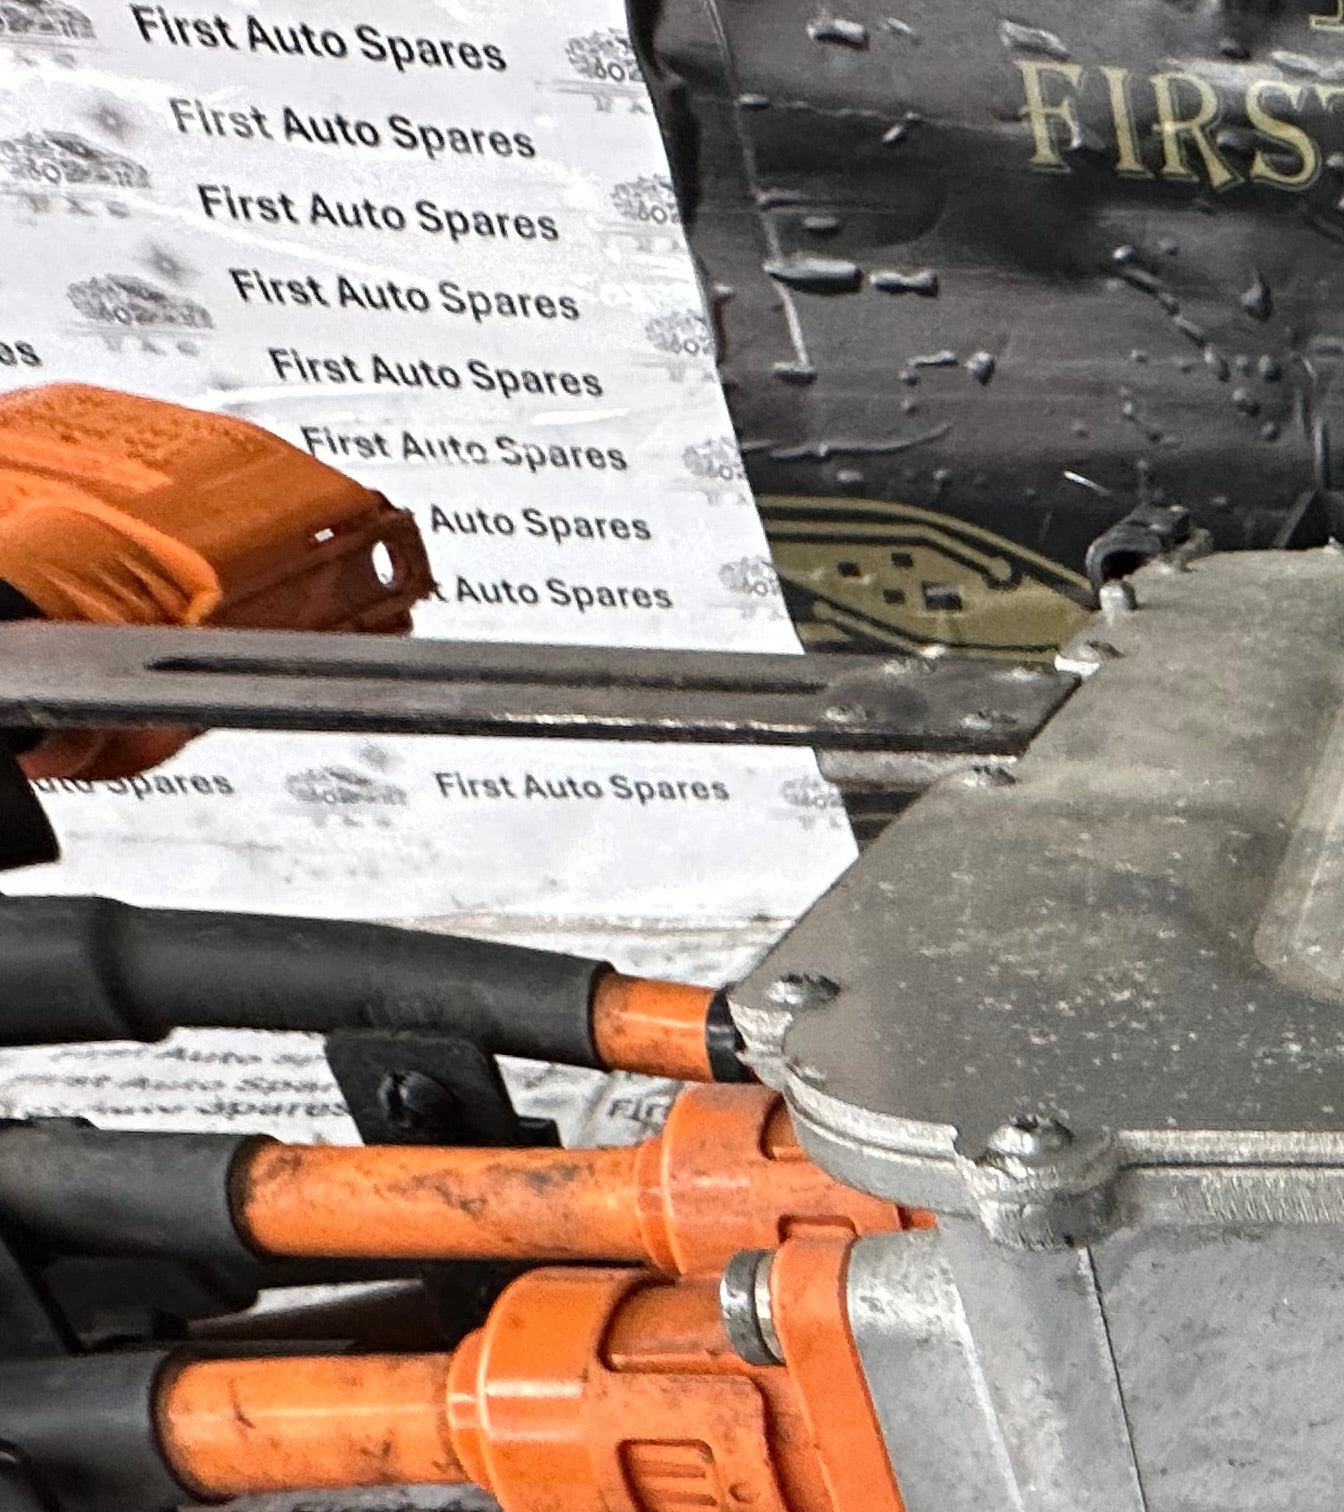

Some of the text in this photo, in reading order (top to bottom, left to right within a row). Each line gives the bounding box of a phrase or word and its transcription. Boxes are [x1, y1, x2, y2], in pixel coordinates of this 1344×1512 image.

[129, 3, 507, 74] First Auto Spares
[169, 98, 537, 160] First Auto Spares
[198, 183, 559, 243] First Auto Spares
[229, 268, 580, 322] First Auto Spares
[268, 346, 603, 399] First Auto Spares
[301, 426, 628, 473] First Auto Spares
[431, 504, 651, 543] Auto Spares
[456, 577, 538, 605] Auto
[547, 578, 674, 611] Spares
[435, 772, 729, 806] First Auto Spares
